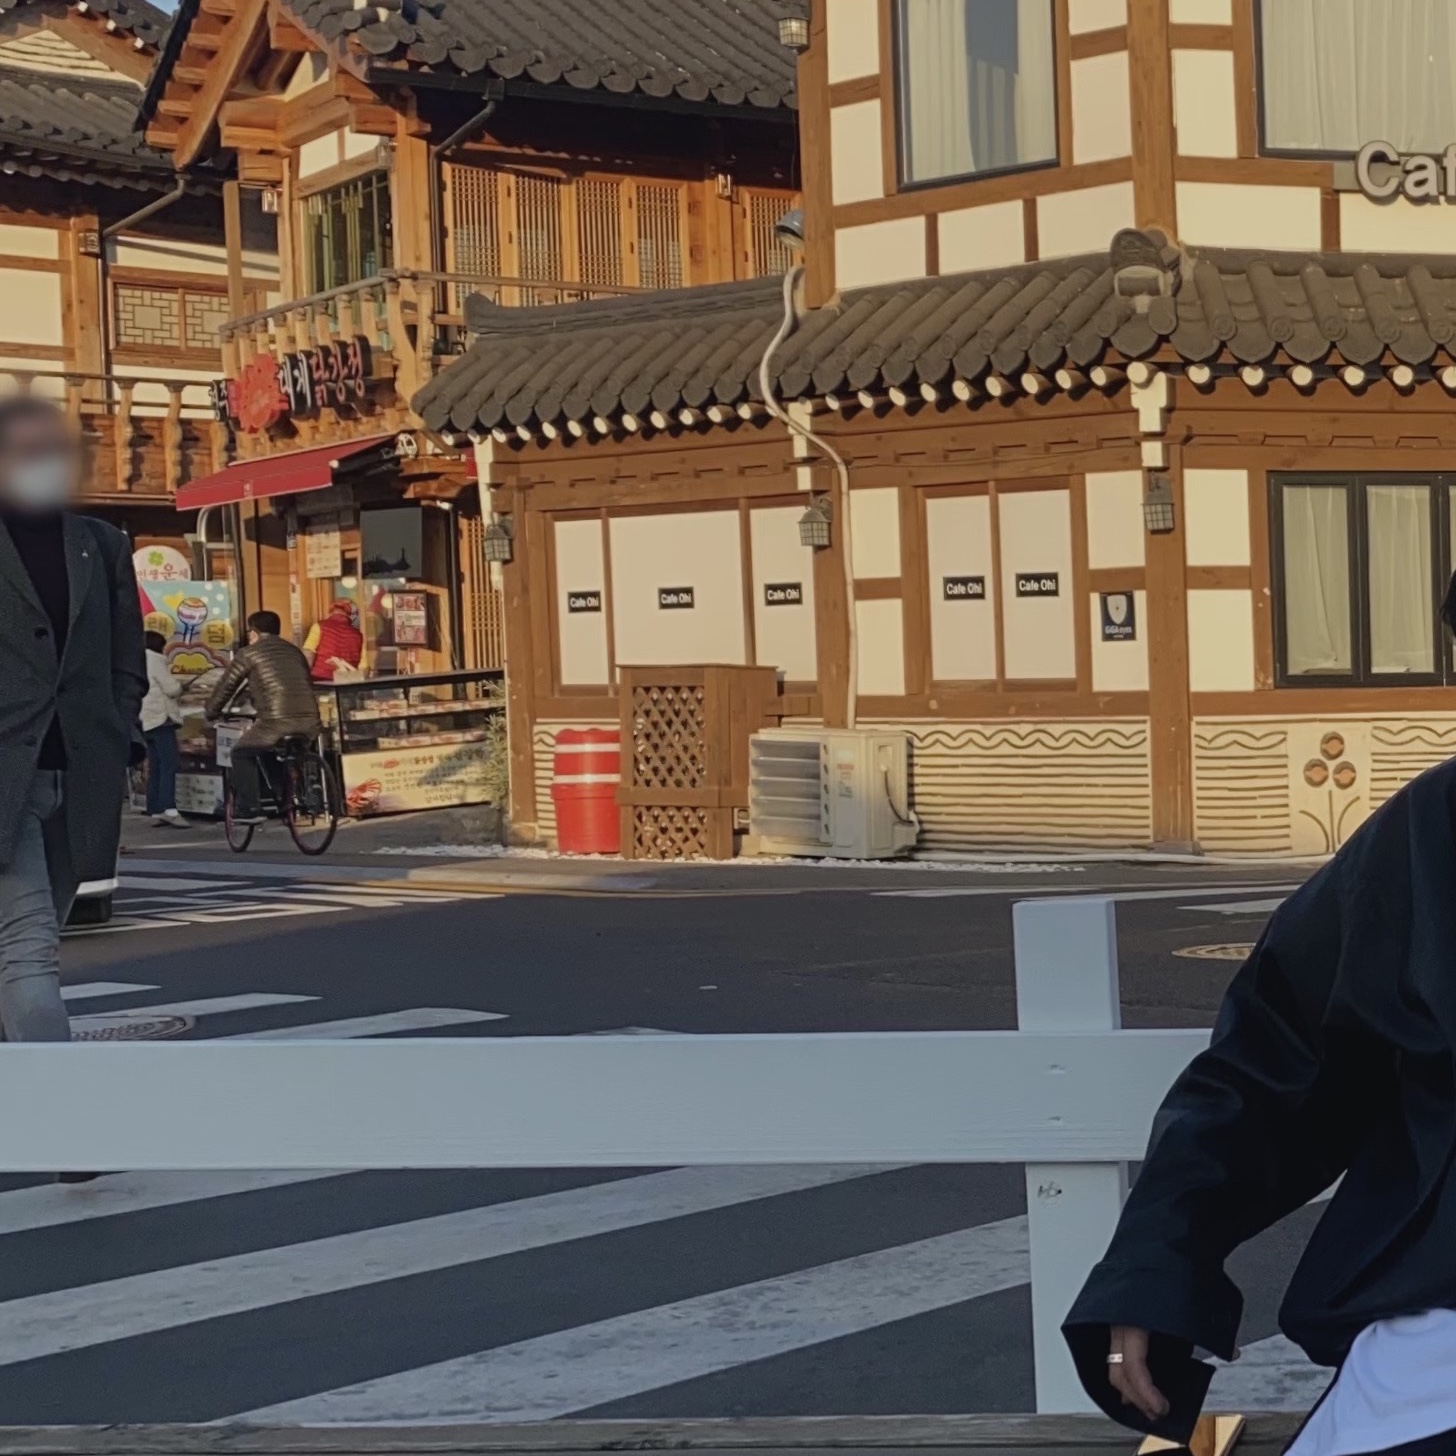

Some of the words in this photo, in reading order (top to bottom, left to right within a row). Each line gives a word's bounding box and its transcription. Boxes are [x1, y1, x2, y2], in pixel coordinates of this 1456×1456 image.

[946, 583, 966, 595] Cafe
[967, 582, 982, 594] Ohi
[1019, 580, 1039, 591] Cafe
[1040, 579, 1056, 591] Ohi
[661, 593, 678, 605] Cafe
[679, 592, 692, 604] Ohi
[767, 589, 785, 600] Cafe
[786, 588, 799, 599] Ohi
[570, 597, 586, 608] Cafe
[586, 596, 599, 607] Ohi
